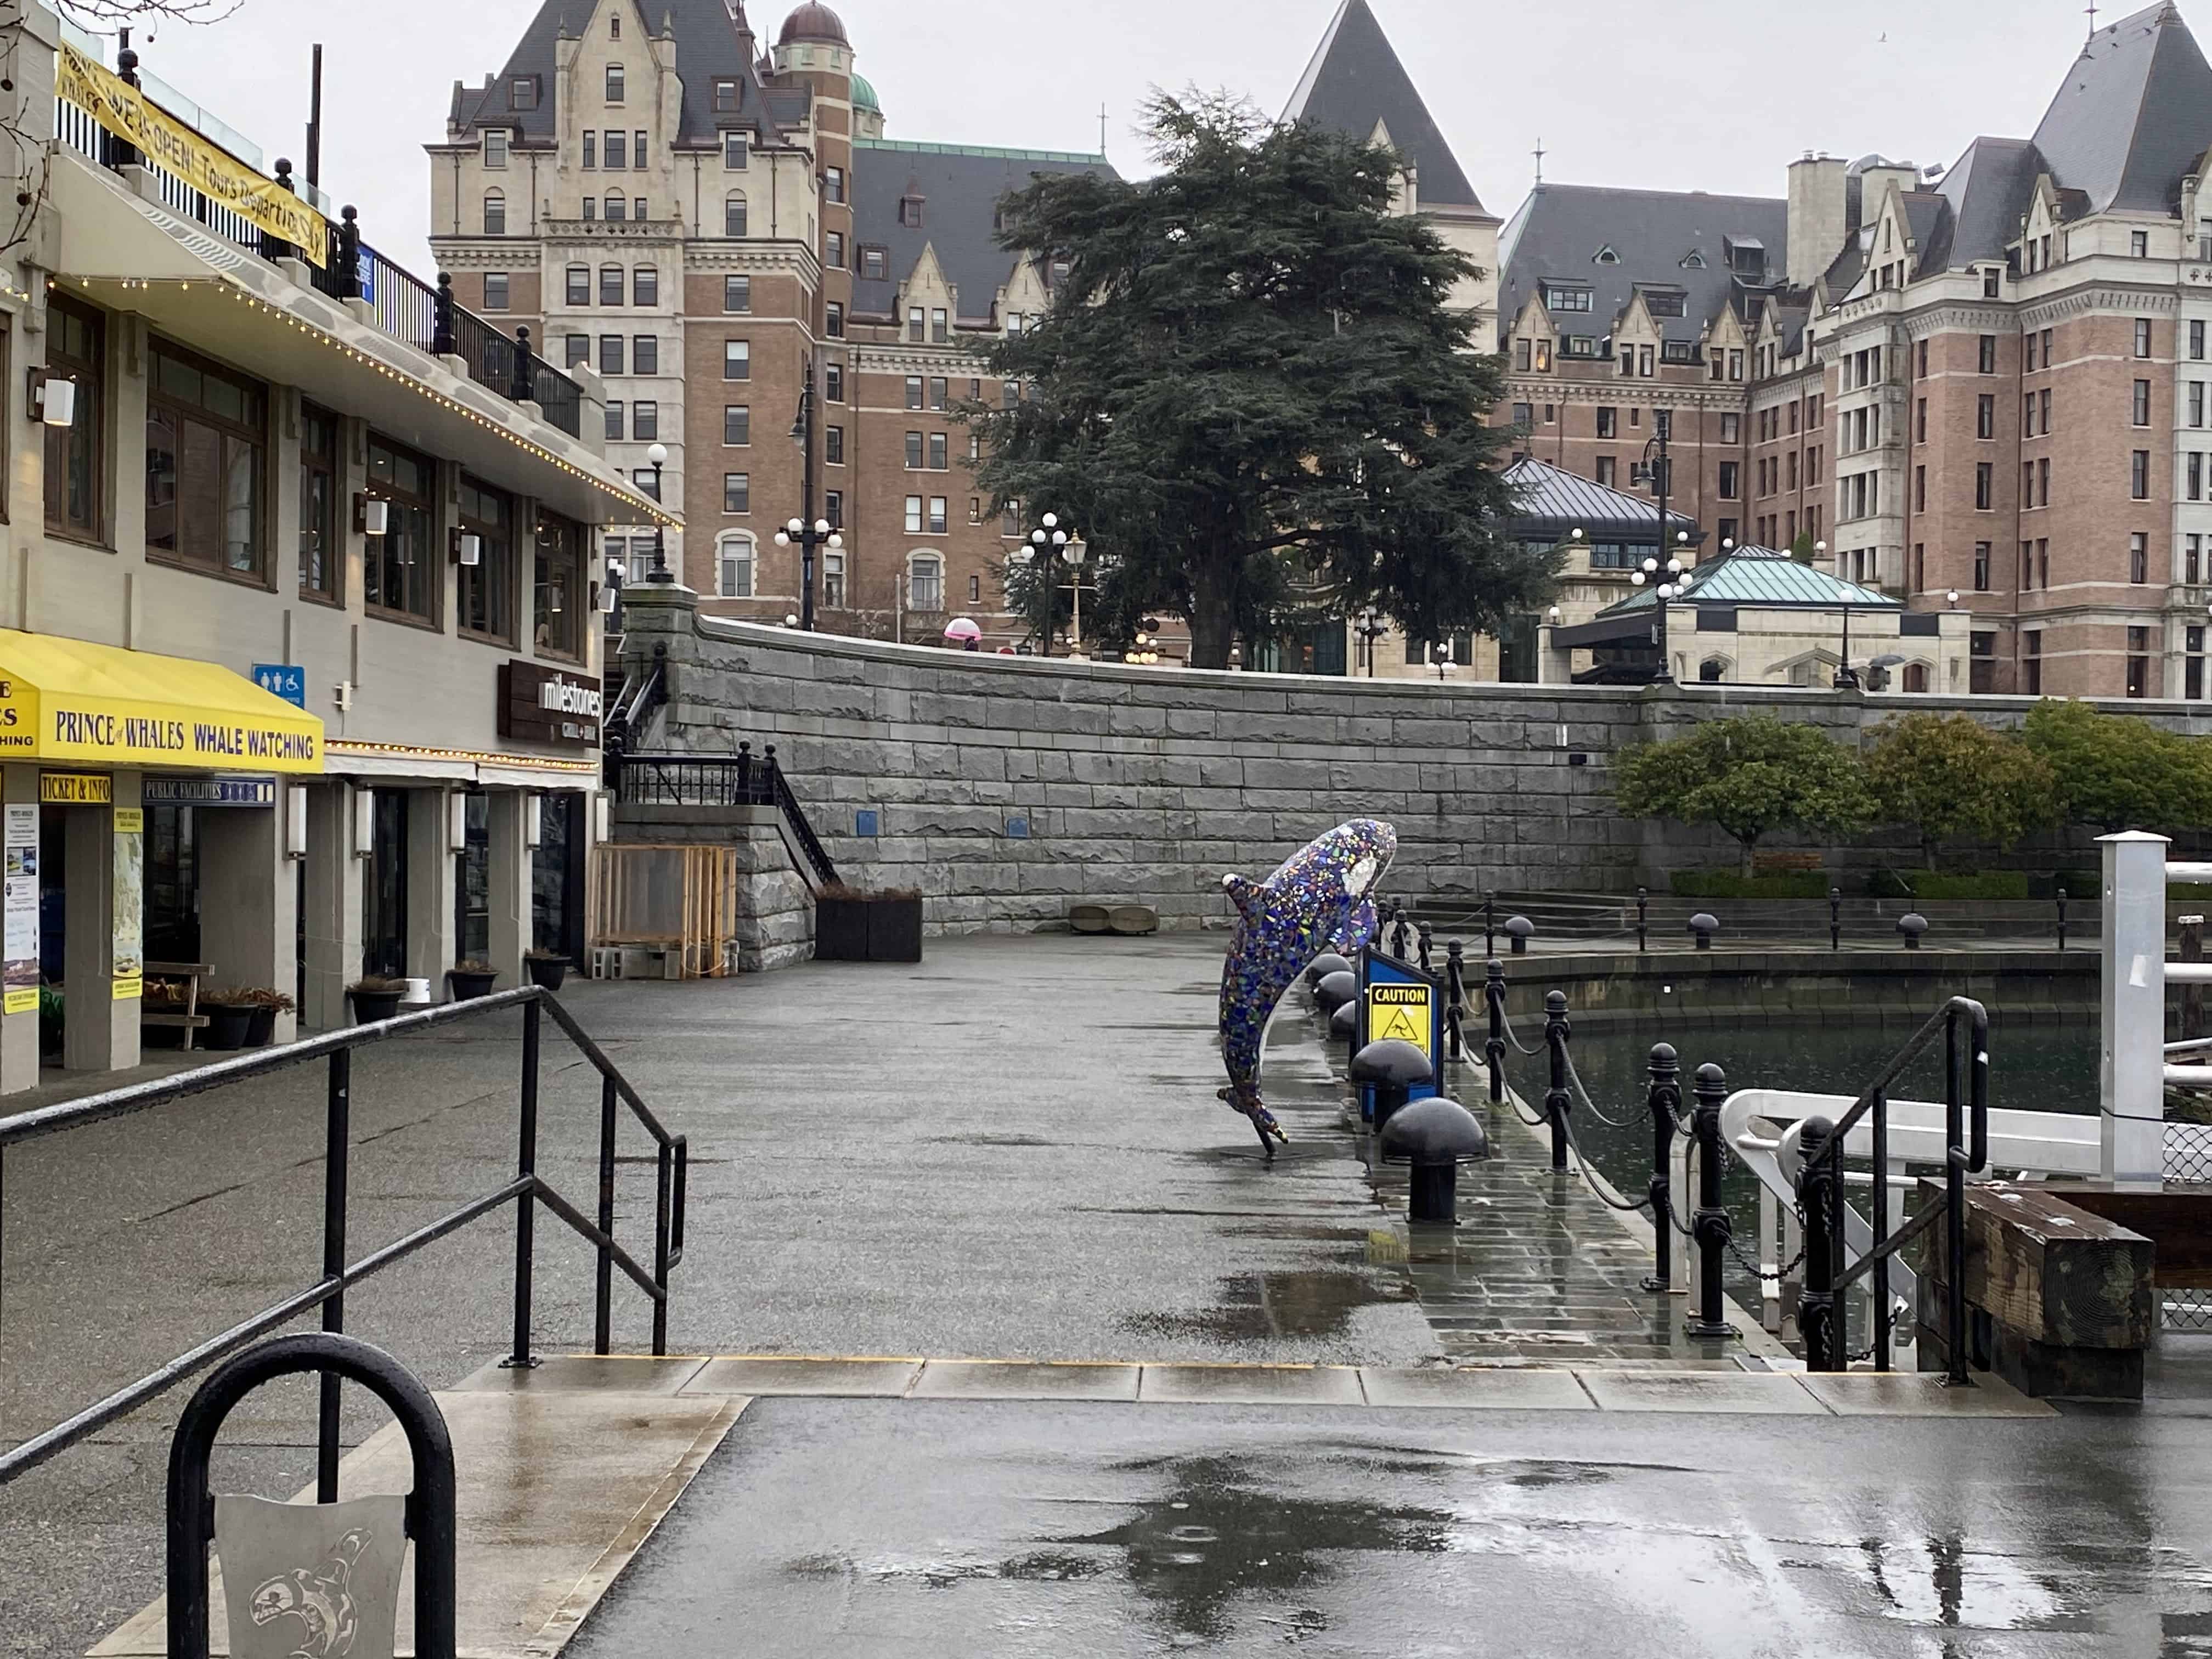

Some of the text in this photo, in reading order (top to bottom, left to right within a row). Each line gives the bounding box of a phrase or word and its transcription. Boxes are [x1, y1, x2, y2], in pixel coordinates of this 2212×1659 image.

[201, 154, 236, 200] Tours
[240, 179, 300, 241] Departing
[543, 673, 600, 717] milestones
[55, 710, 115, 746] PRINCE
[125, 718, 184, 750] WHALES
[194, 723, 242, 755] WHALE
[247, 730, 313, 760] WATCHING
[42, 776, 110, 800] TICKET & INFO
[146, 781, 222, 799] PUBLIC FACILITIES
[1375, 989, 1425, 1002] CAUTION
